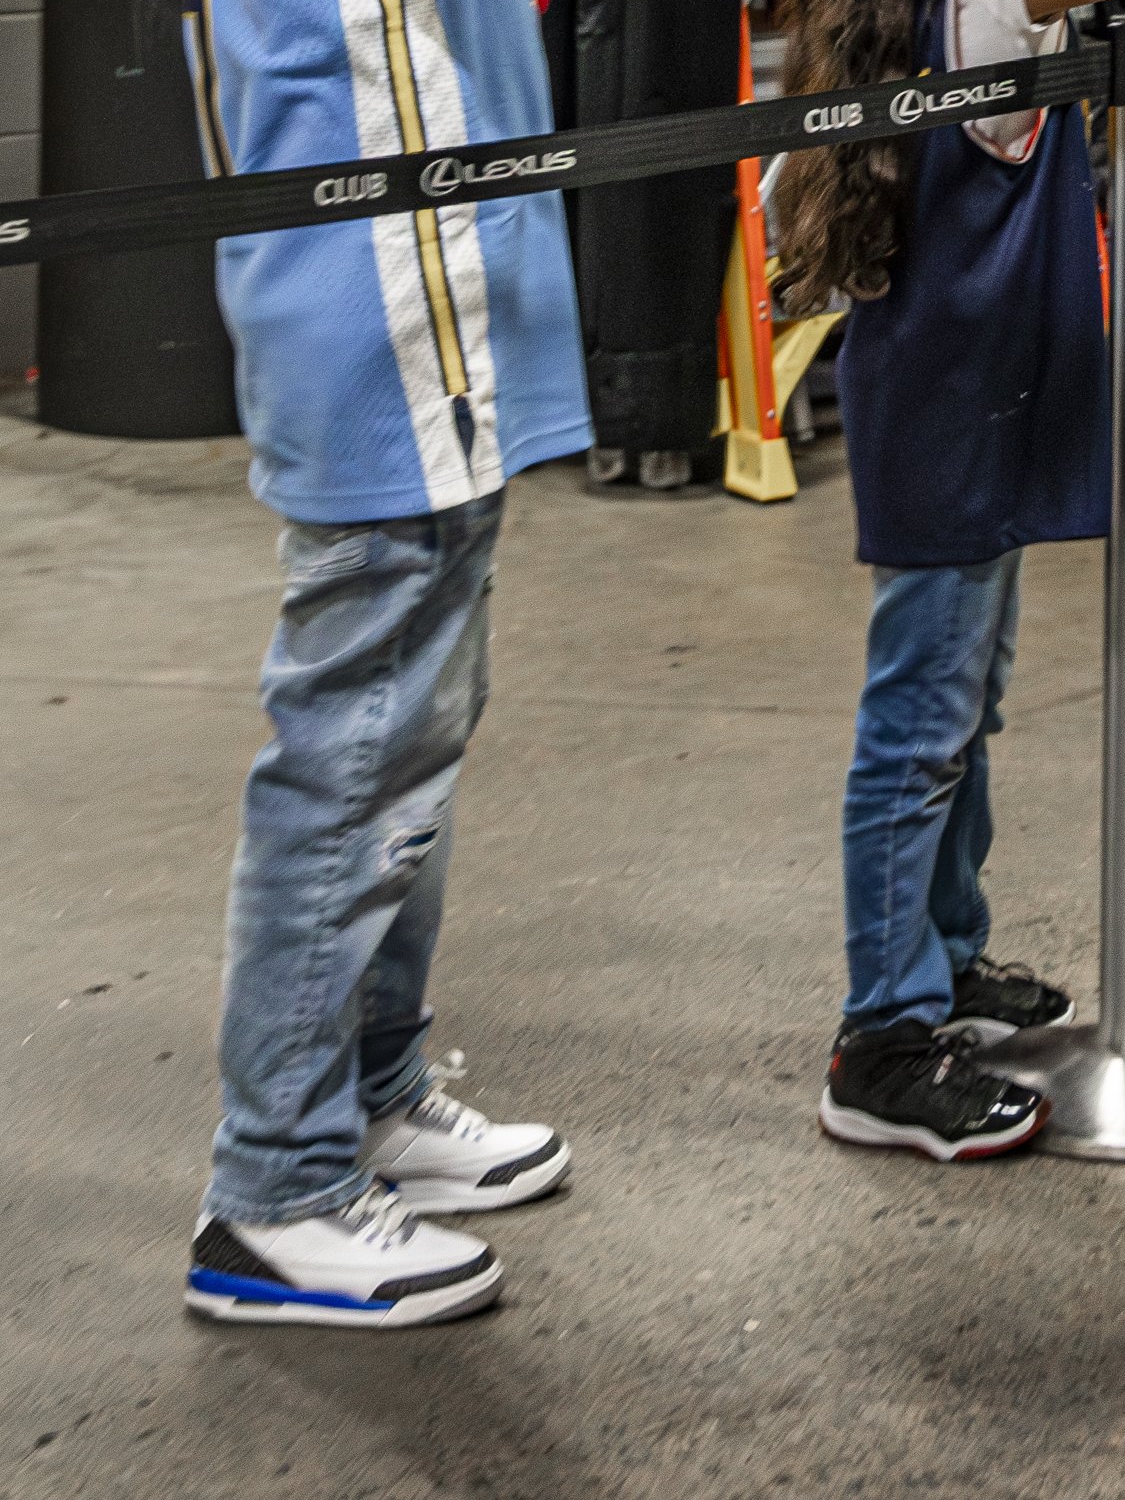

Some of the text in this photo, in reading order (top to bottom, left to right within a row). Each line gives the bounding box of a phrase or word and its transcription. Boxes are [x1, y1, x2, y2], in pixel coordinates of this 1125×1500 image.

[803, 78, 1018, 134] CLUB LEXUS
[313, 149, 578, 207] CLUB LEXUS
